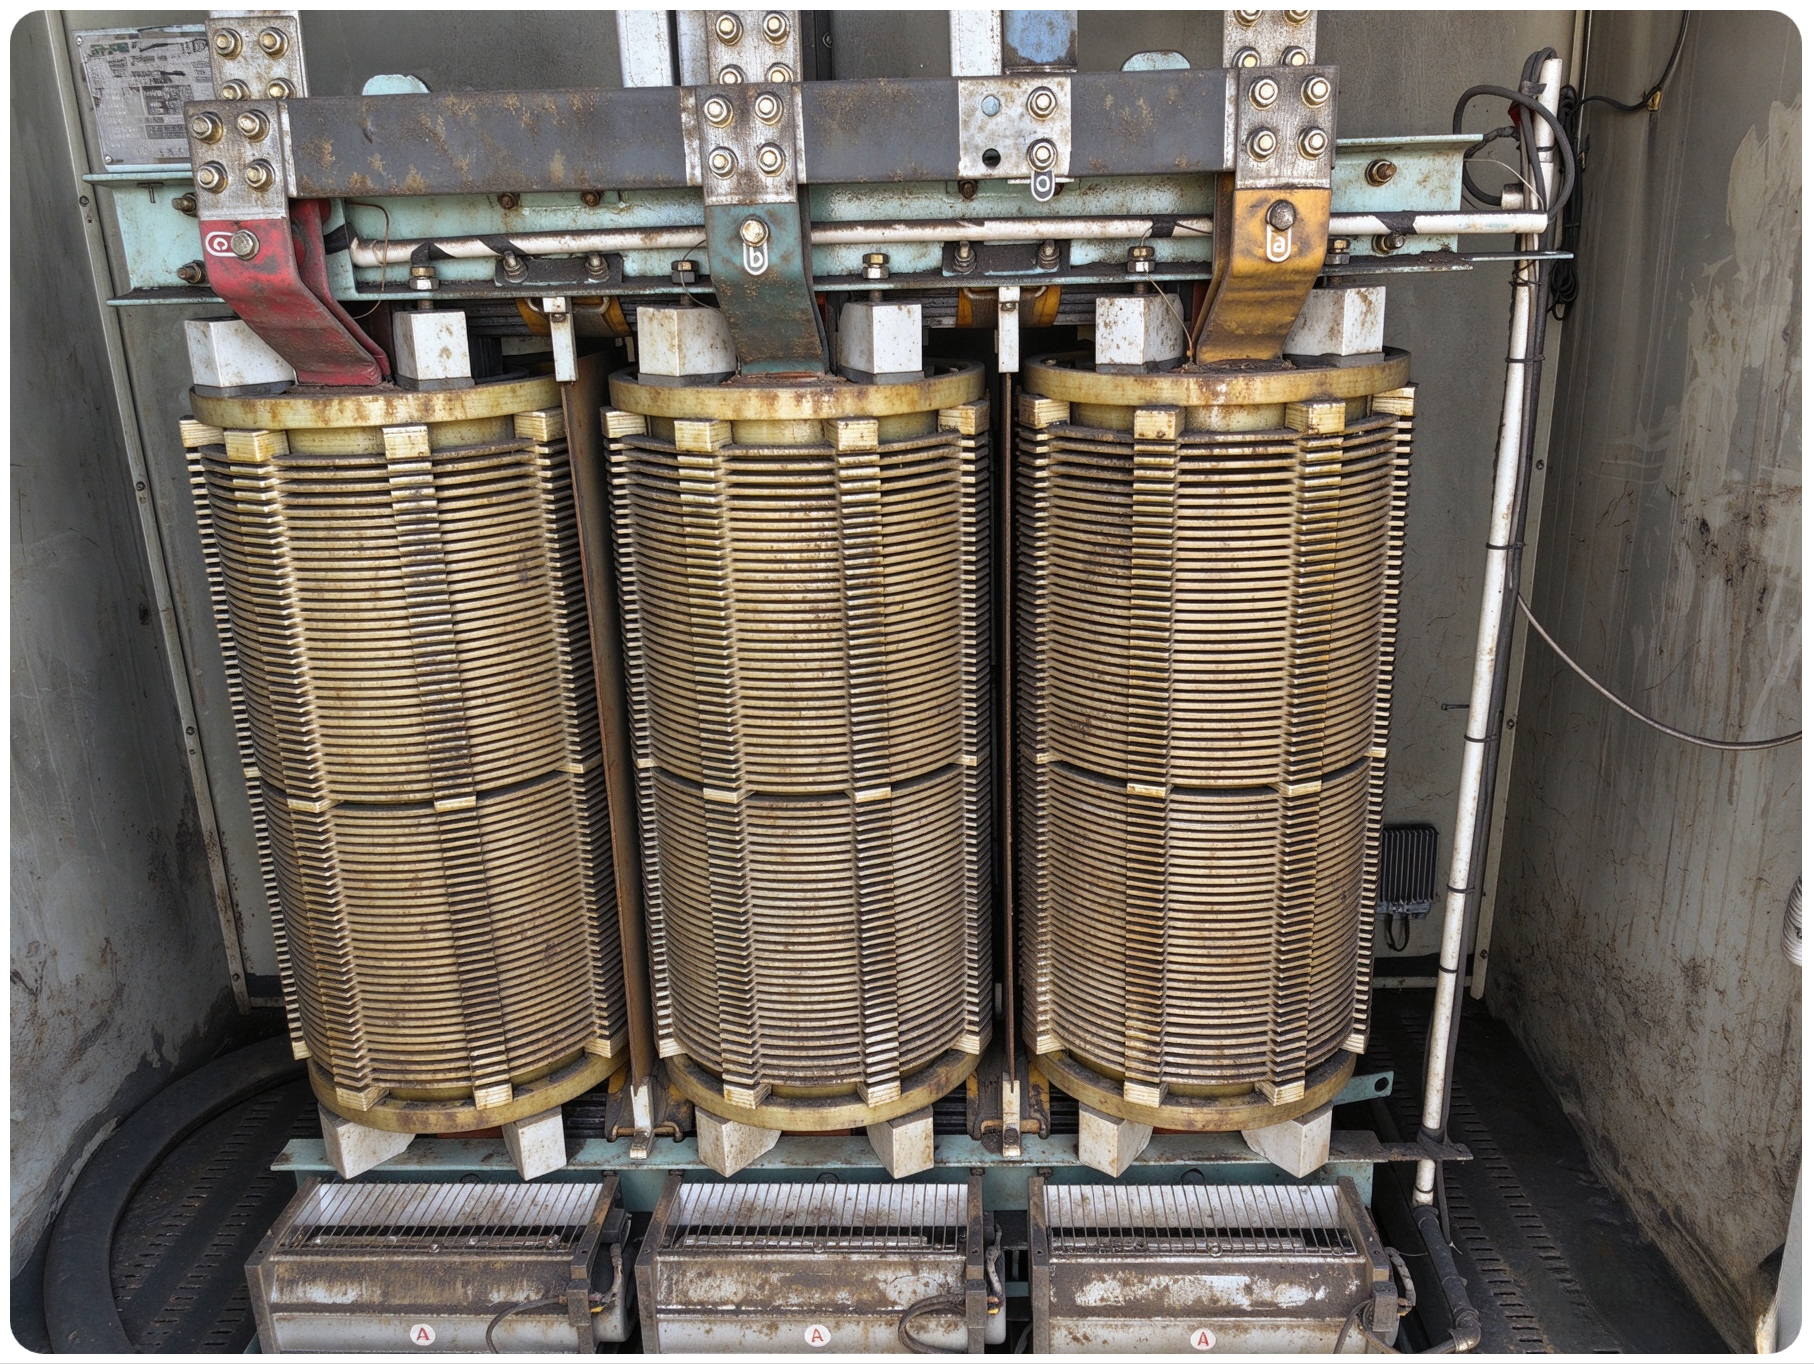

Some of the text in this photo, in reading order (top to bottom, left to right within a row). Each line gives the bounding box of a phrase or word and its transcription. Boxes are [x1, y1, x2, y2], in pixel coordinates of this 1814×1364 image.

[750, 246, 763, 267] b
[416, 1327, 431, 1342] A
[811, 1328, 824, 1343] A
[1197, 1331, 1210, 1347] A
